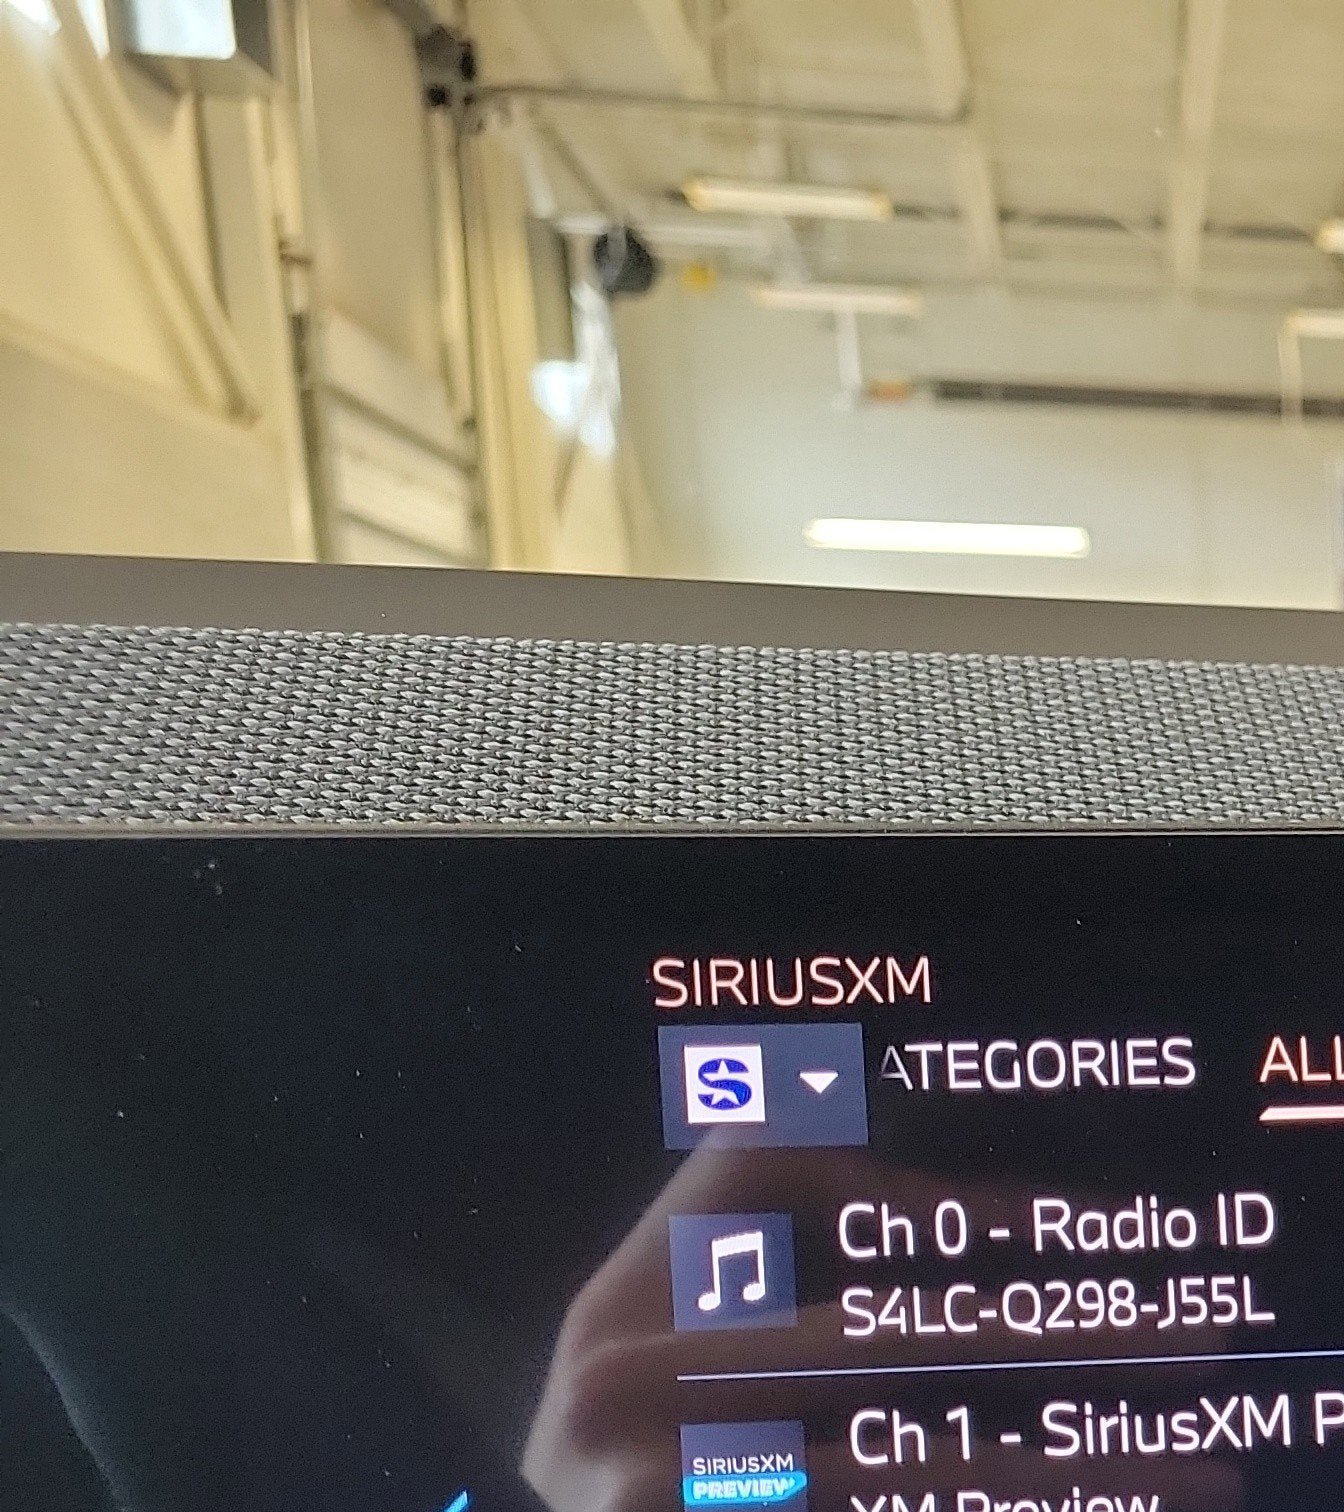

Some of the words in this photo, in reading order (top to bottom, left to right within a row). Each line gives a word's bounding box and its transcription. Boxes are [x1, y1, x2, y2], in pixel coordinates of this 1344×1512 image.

[652, 955, 932, 1008] SIRIUSXM
[838, 1202, 915, 1259] Ch
[934, 1200, 968, 1256] 0
[1032, 1195, 1197, 1252] Radio
[1217, 1192, 1275, 1246] ID
[841, 1275, 1276, 1337] S4LC-Q298-J55L
[850, 1409, 926, 1466] Ch
[946, 1405, 971, 1461] 1
[1041, 1393, 1292, 1457] SiriusXM
[692, 1452, 794, 1476] SIRIUSXM
[693, 1478, 795, 1499] PREVIEW
